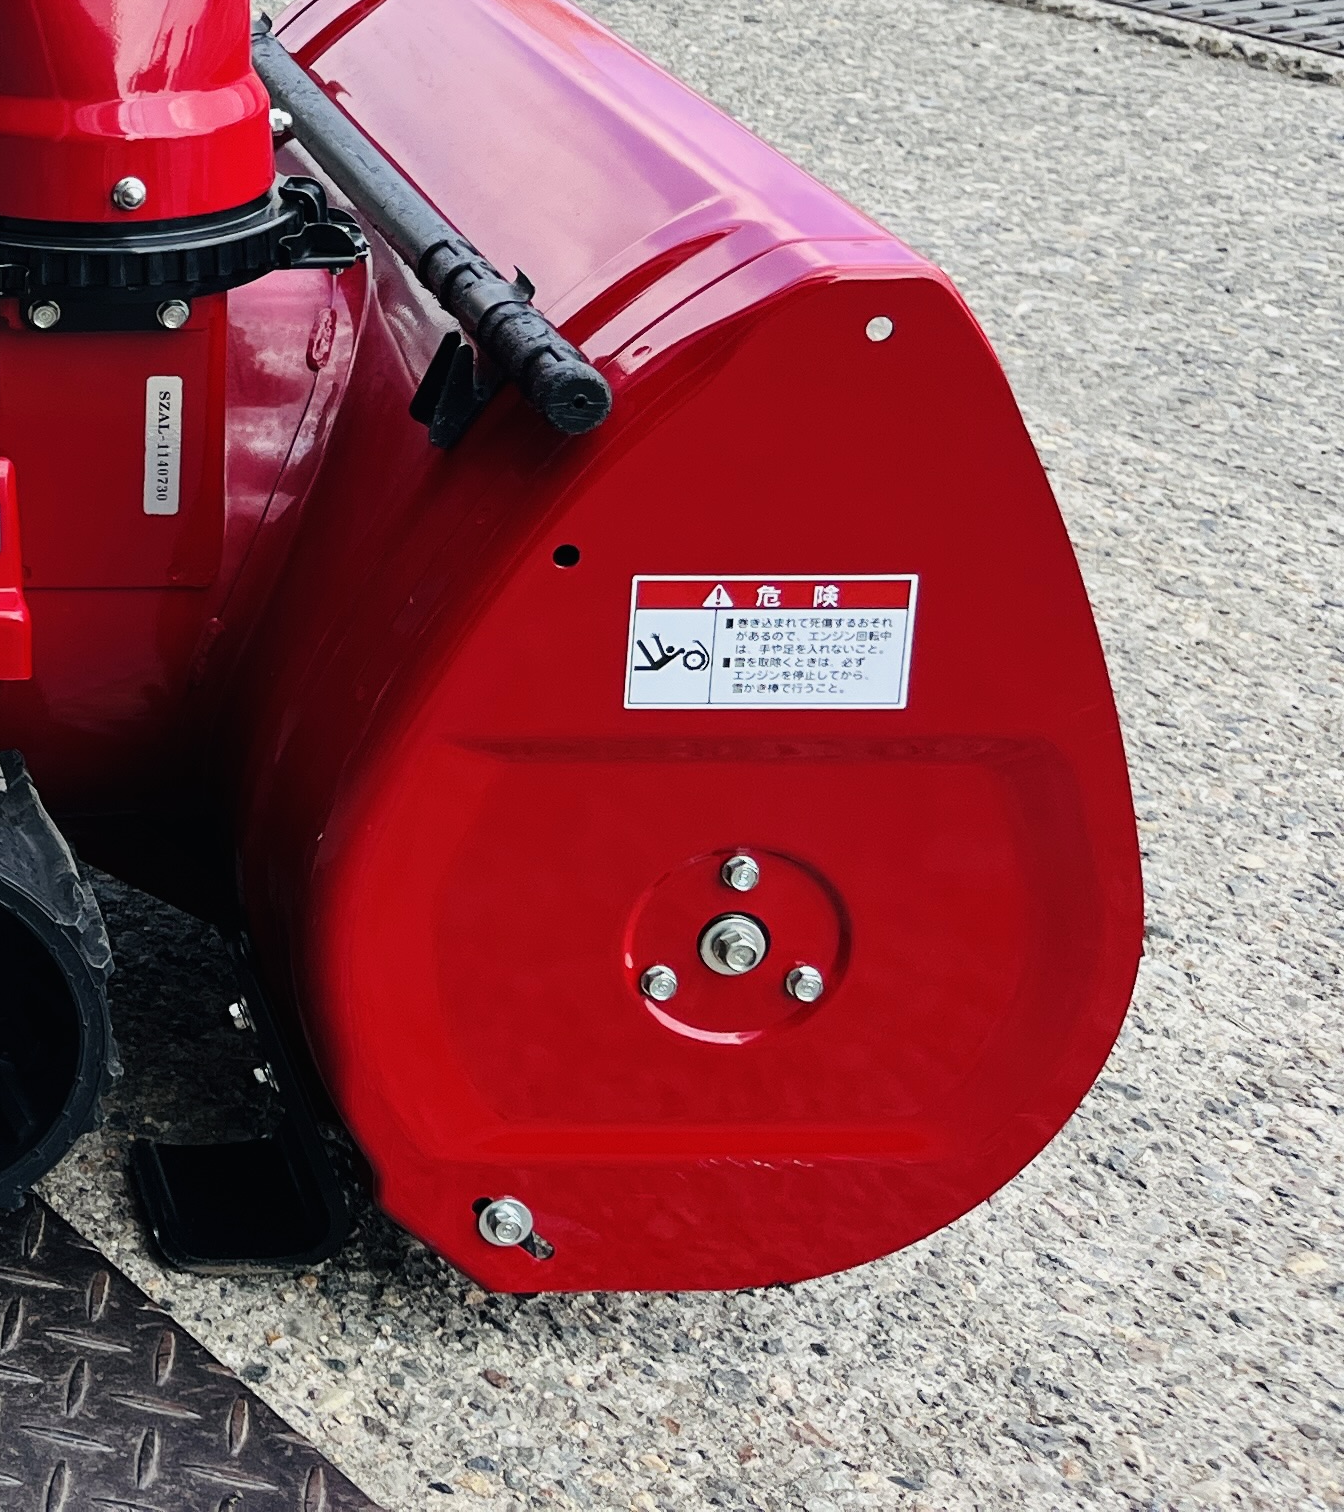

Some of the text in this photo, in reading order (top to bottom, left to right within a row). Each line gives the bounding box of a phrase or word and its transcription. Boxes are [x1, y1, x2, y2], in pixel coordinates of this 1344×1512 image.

[156, 391, 171, 501] SZAL-1140730
[756, 584, 839, 608] 危険
[737, 618, 893, 629] 巻き込まれて死傷するおそれ
[736, 631, 892, 642] があるので、エンジン回転中
[732, 683, 846, 694] 雪かき棒で行うこと。
